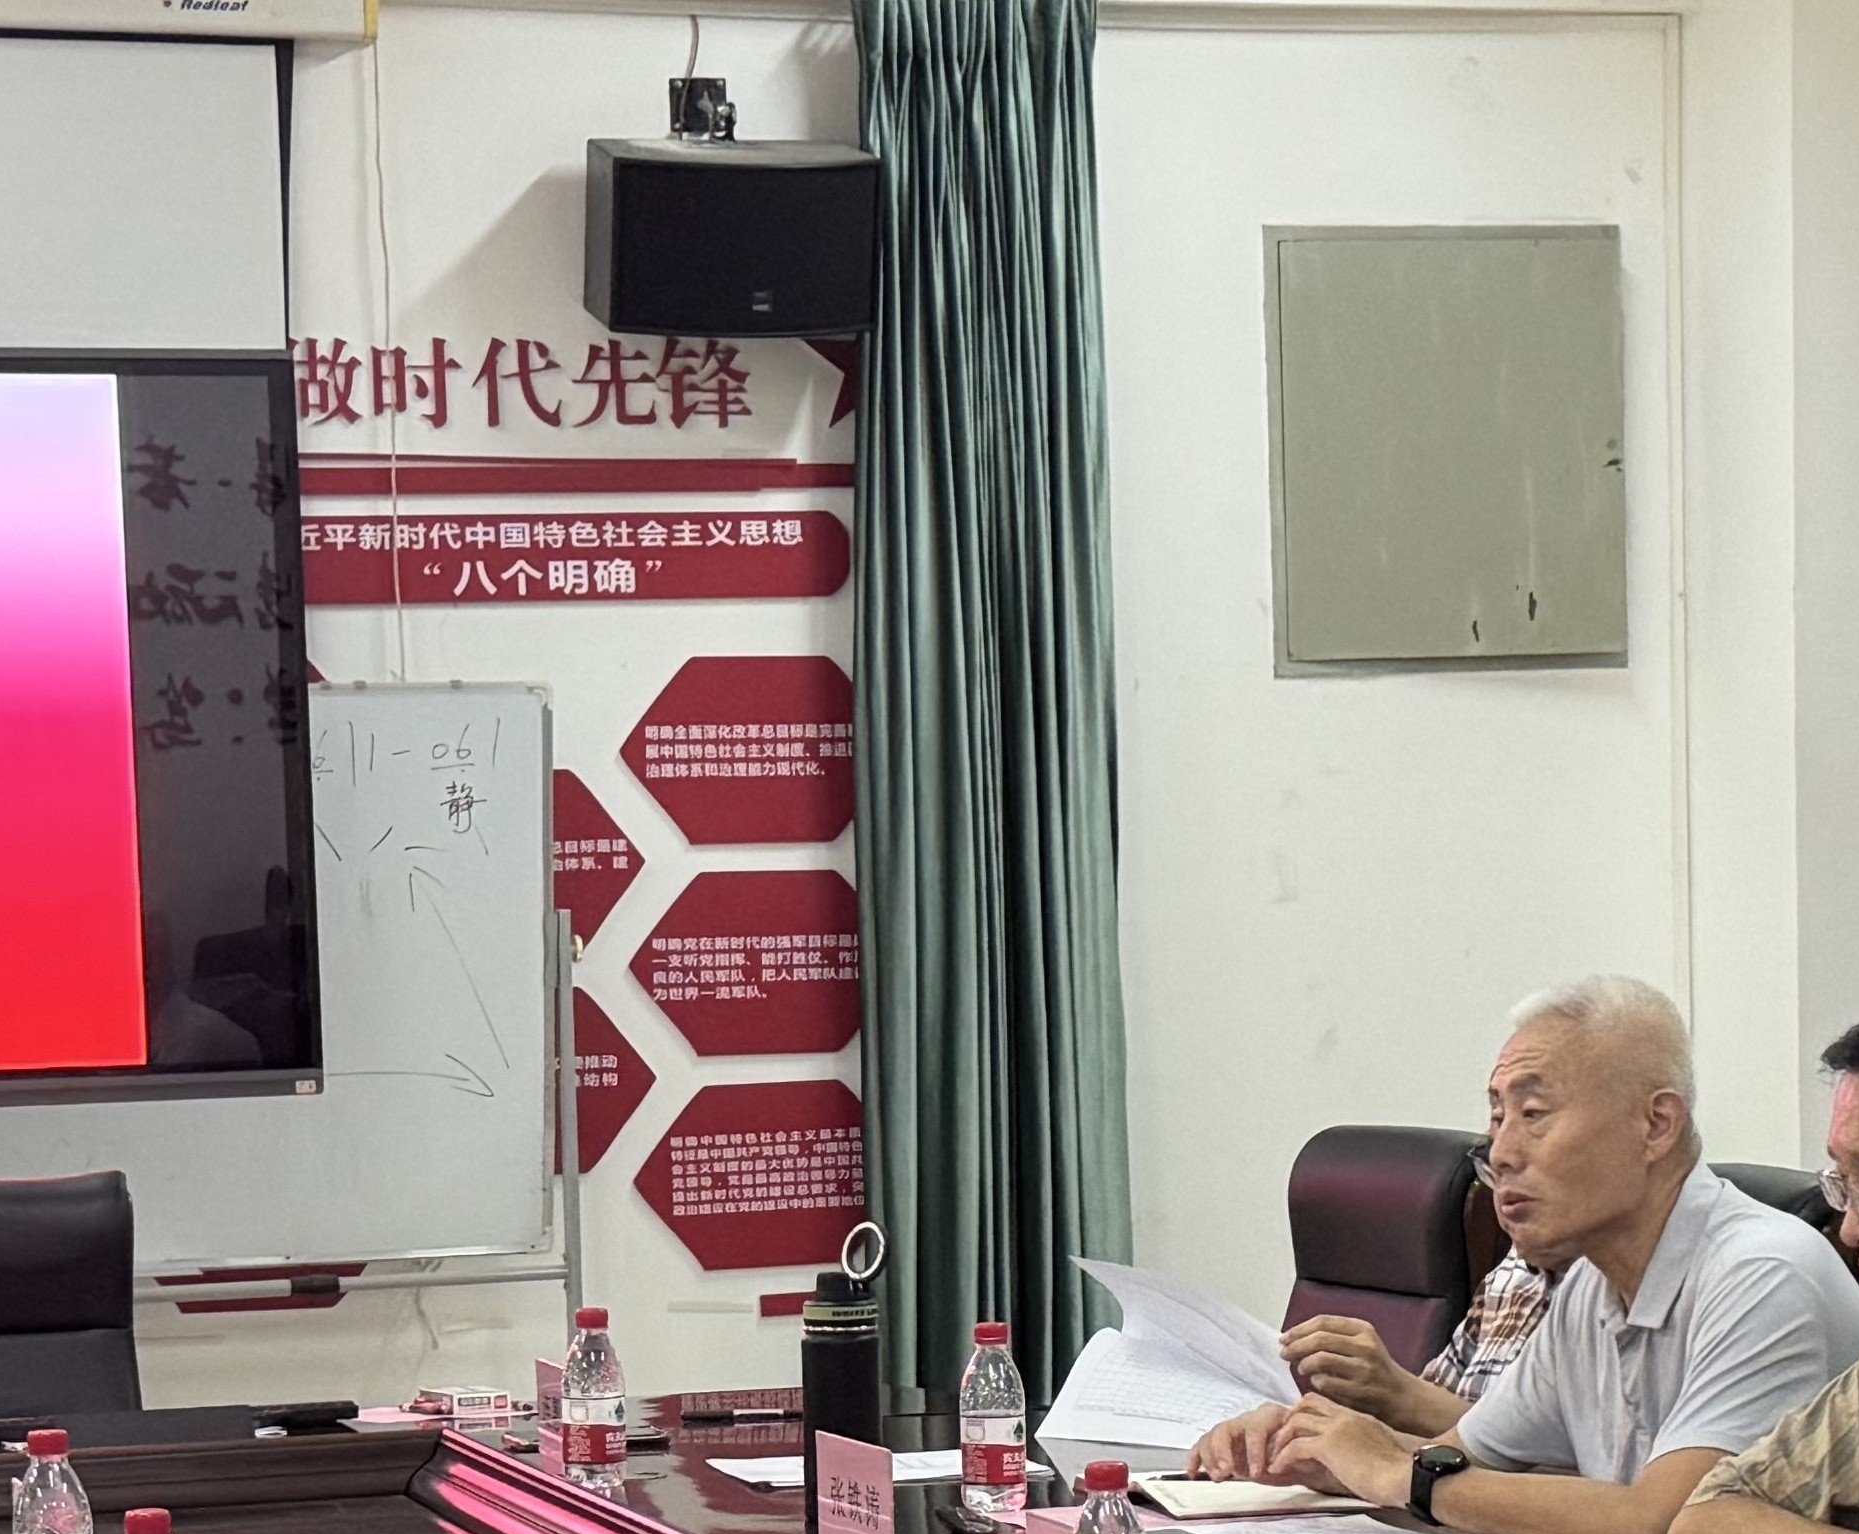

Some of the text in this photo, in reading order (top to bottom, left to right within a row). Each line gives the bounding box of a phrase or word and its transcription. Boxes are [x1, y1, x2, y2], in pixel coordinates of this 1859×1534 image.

[288, 335, 753, 431] 做时代先锋
[301, 519, 804, 552] 近平新时代中国特色社会主义思想
